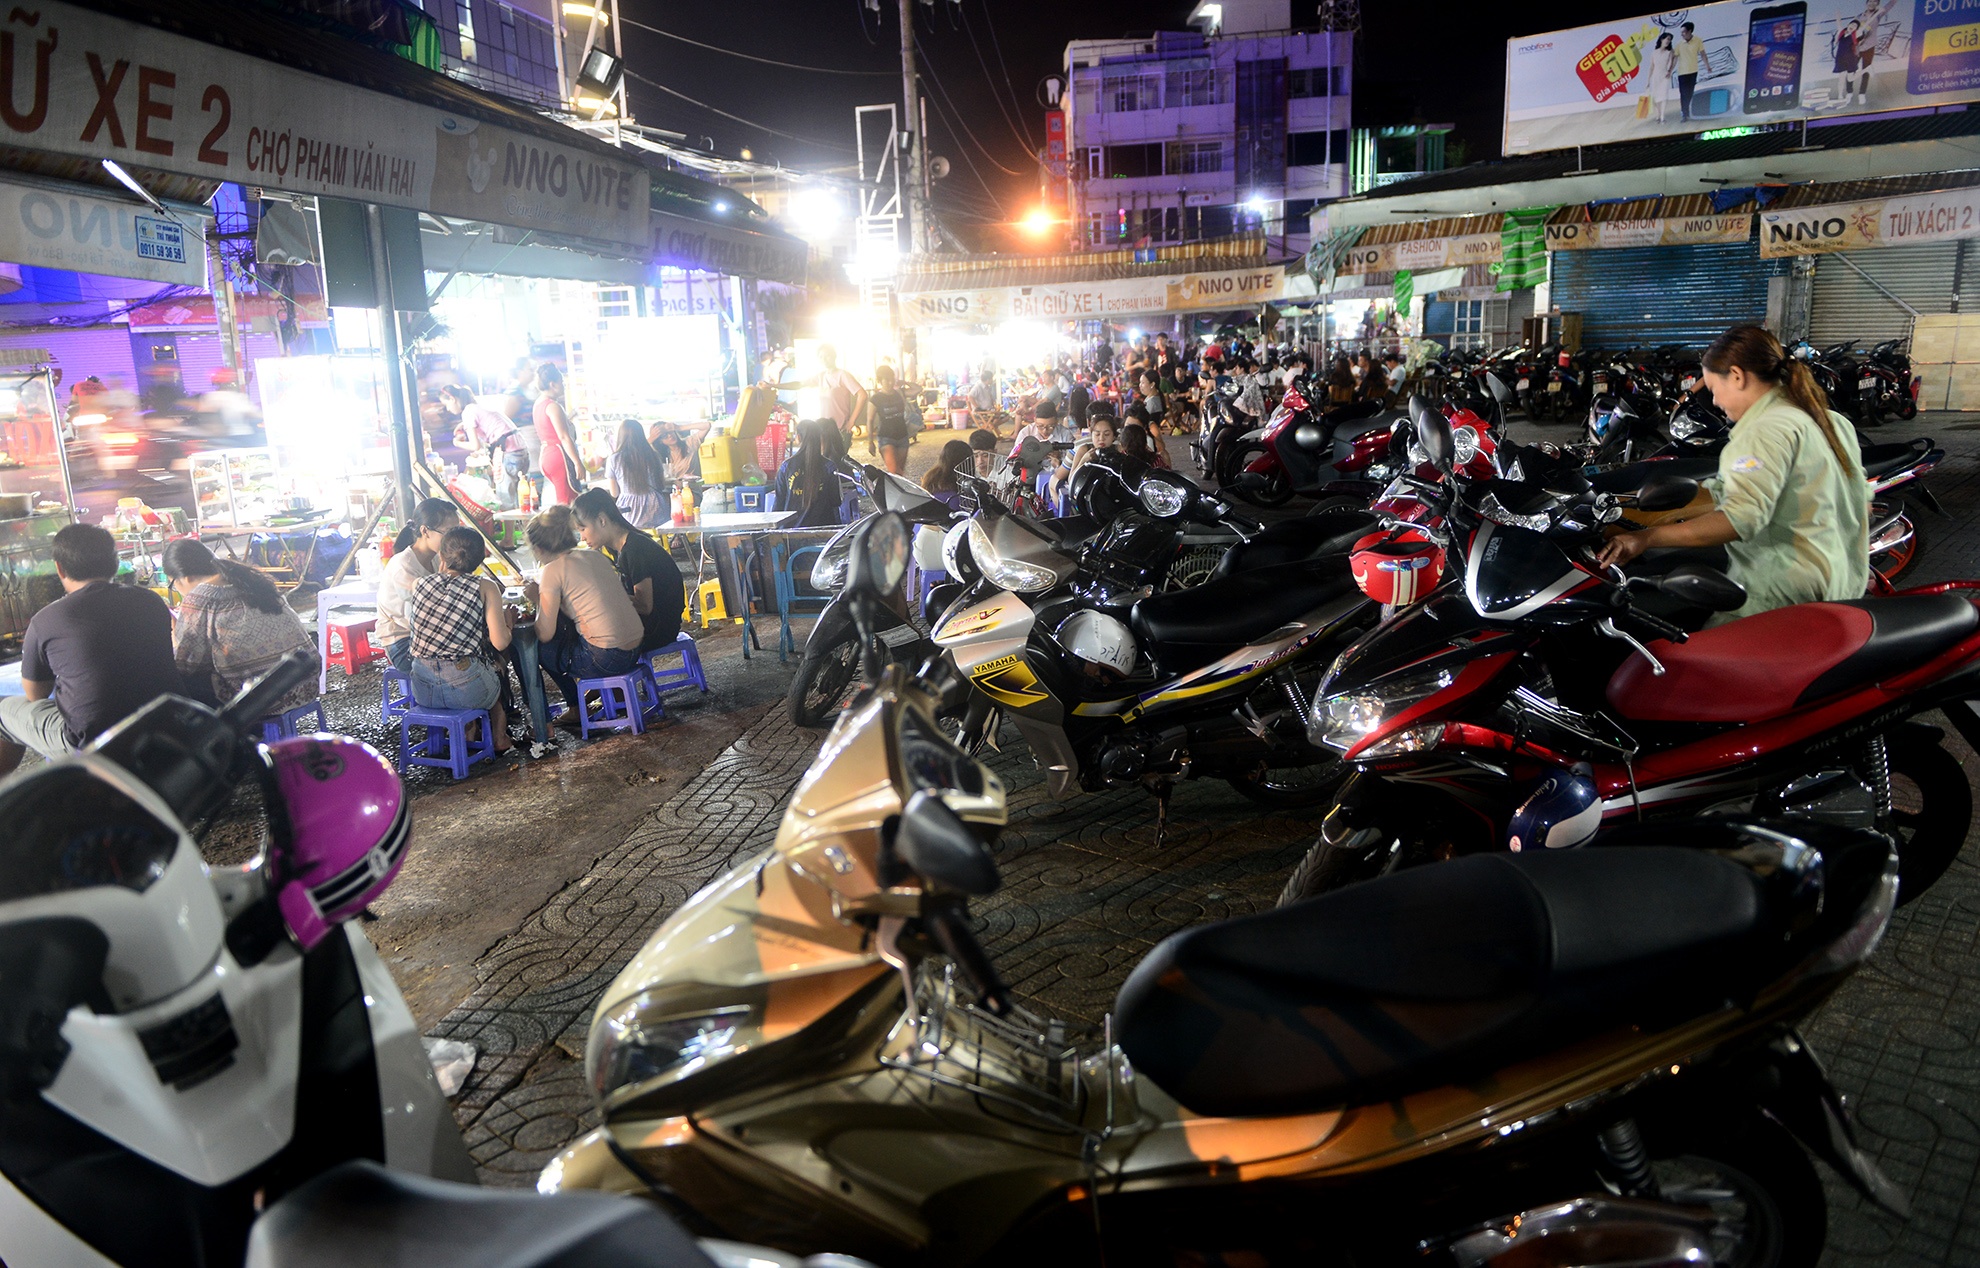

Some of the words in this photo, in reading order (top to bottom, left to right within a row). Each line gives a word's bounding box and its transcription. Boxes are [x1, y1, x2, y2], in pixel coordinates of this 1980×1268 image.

[1962, 0, 1980, 10] M
[1600, 24, 1659, 83] 50%
[80, 51, 176, 157] XE
[198, 84, 232, 167] 2
[246, 127, 292, 184] CHỢ
[295, 139, 348, 192] PHẠM
[353, 141, 389, 192] VĂN
[391, 157, 416, 198] HAI
[503, 142, 568, 198] NNO
[576, 158, 632, 211] VITE
[1606, 217, 1656, 231] FASHION
[1685, 219, 1713, 233] NNO
[1717, 217, 1745, 232] VITE
[1890, 206, 1912, 237] TÚI
[1916, 203, 1956, 235] XÁCH
[1961, 205, 1973, 230] 2
[1770, 217, 1846, 243] NNO
[140, 242, 155, 256] 0911
[156, 245, 164, 257] 59
[1401, 239, 1442, 255] FASHION
[1464, 242, 1488, 254] NNO
[1198, 277, 1233, 294] NNO
[1237, 273, 1274, 290] VITE
[920, 296, 969, 314] NNO
[1043, 289, 1069, 315] GIỮ
[1073, 292, 1092, 314] XE
[1097, 292, 1103, 312] 1
[1107, 298, 1121, 312] CHỢ
[1153, 295, 1164, 307] HAI
[974, 656, 1015, 673] YAMAHA
